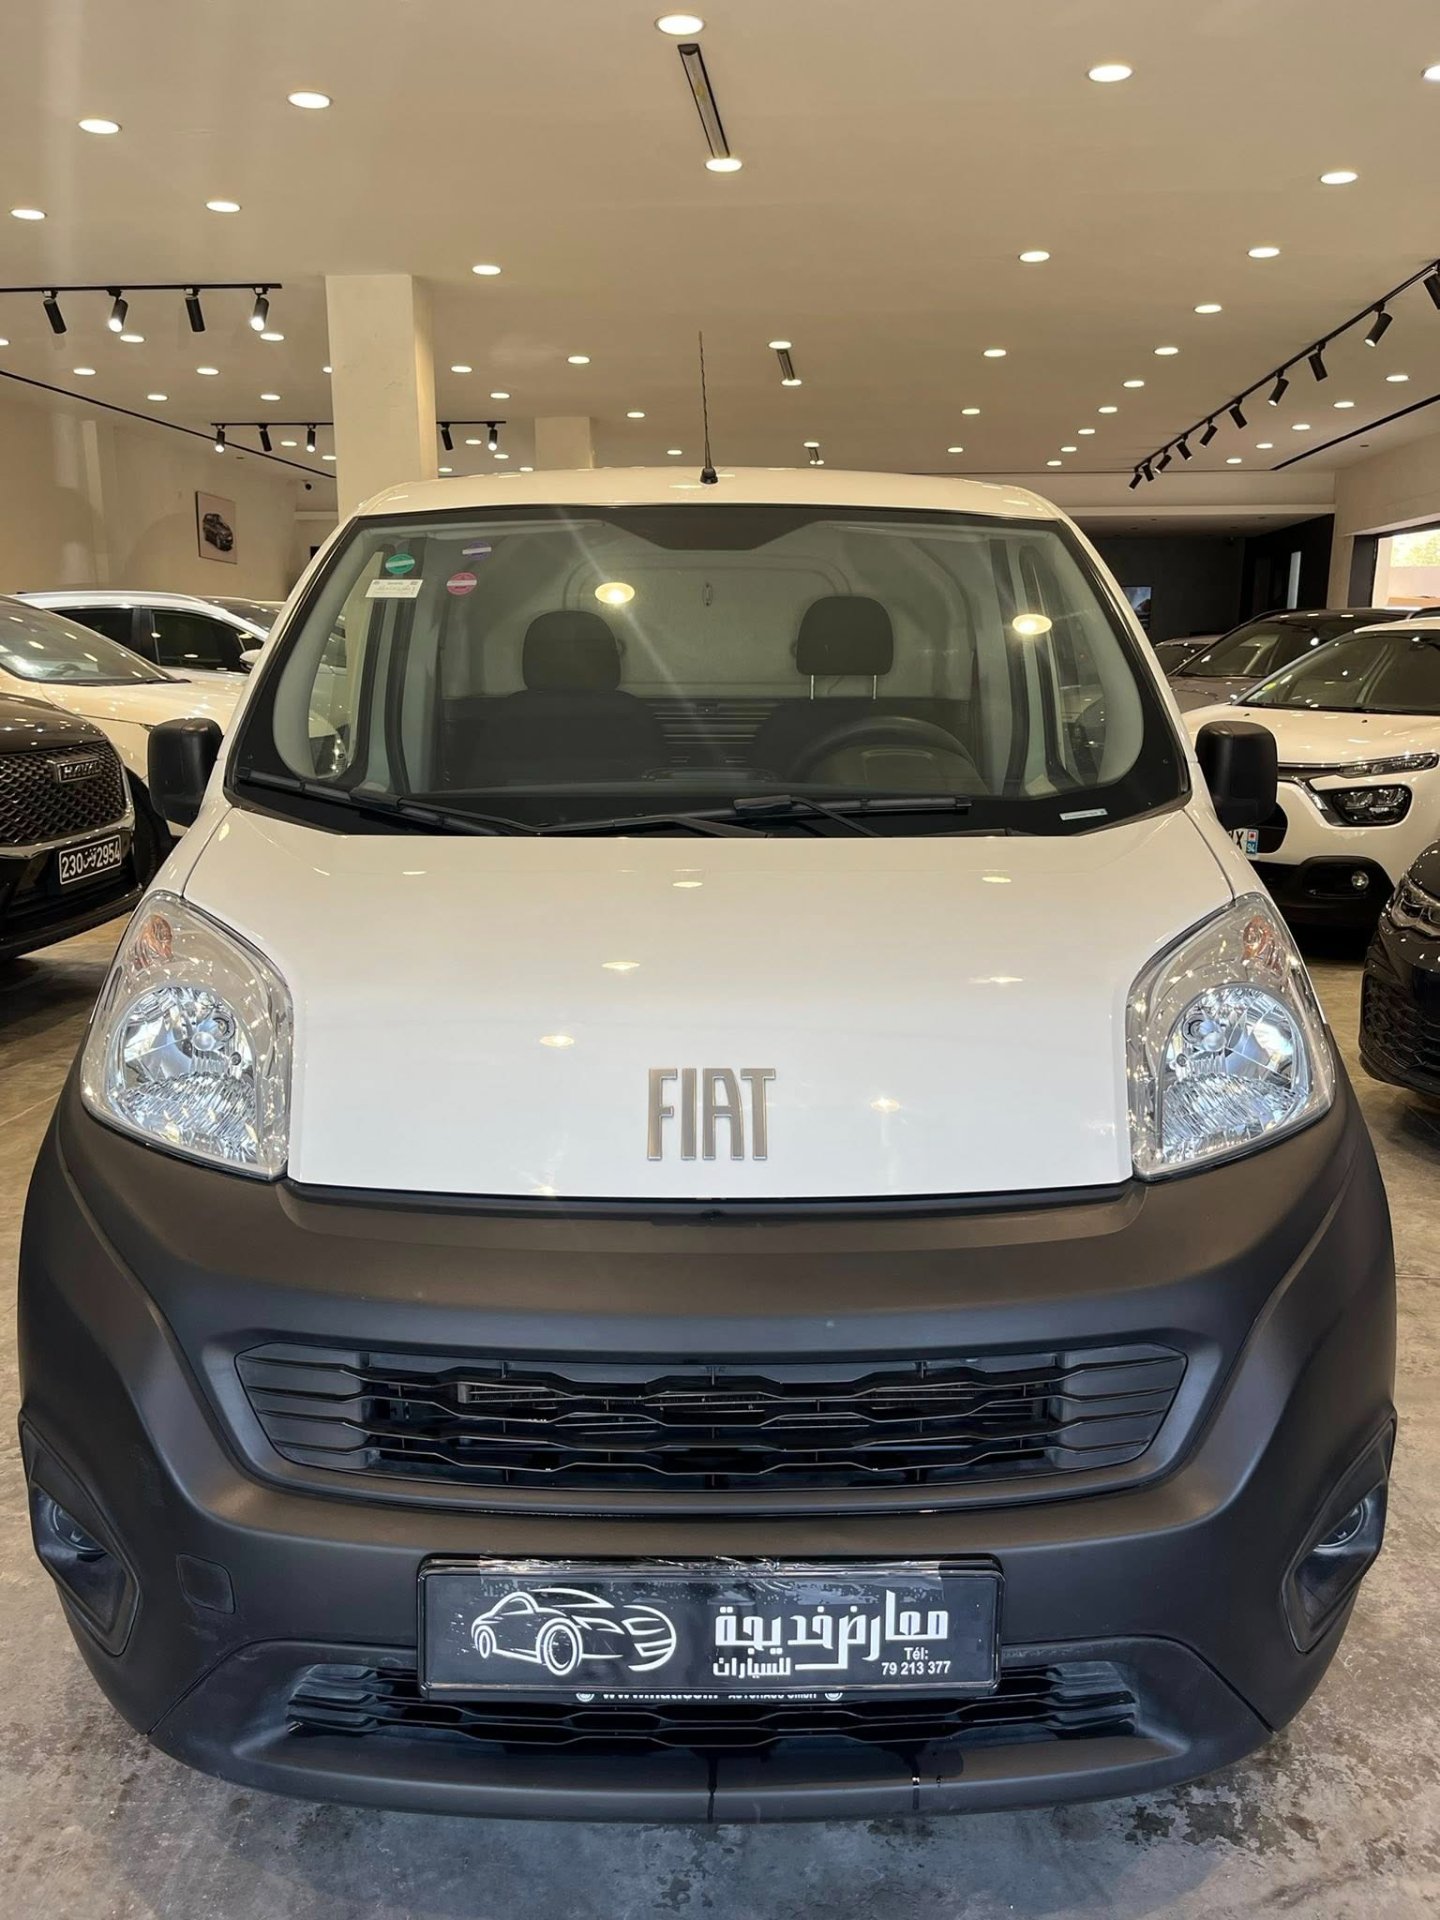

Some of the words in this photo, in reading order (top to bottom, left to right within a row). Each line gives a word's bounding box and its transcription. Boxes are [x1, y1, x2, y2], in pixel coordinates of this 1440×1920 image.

[647, 1068, 776, 1161] FIAT
[715, 1606, 834, 1655] خديجة
[795, 1589, 949, 1670] معارض
[712, 1657, 792, 1679] للسيارات
[881, 1662, 898, 1676] 79
[900, 1661, 925, 1676] 213
[927, 1660, 952, 1675] 377
[904, 1646, 929, 1661] Tél:
